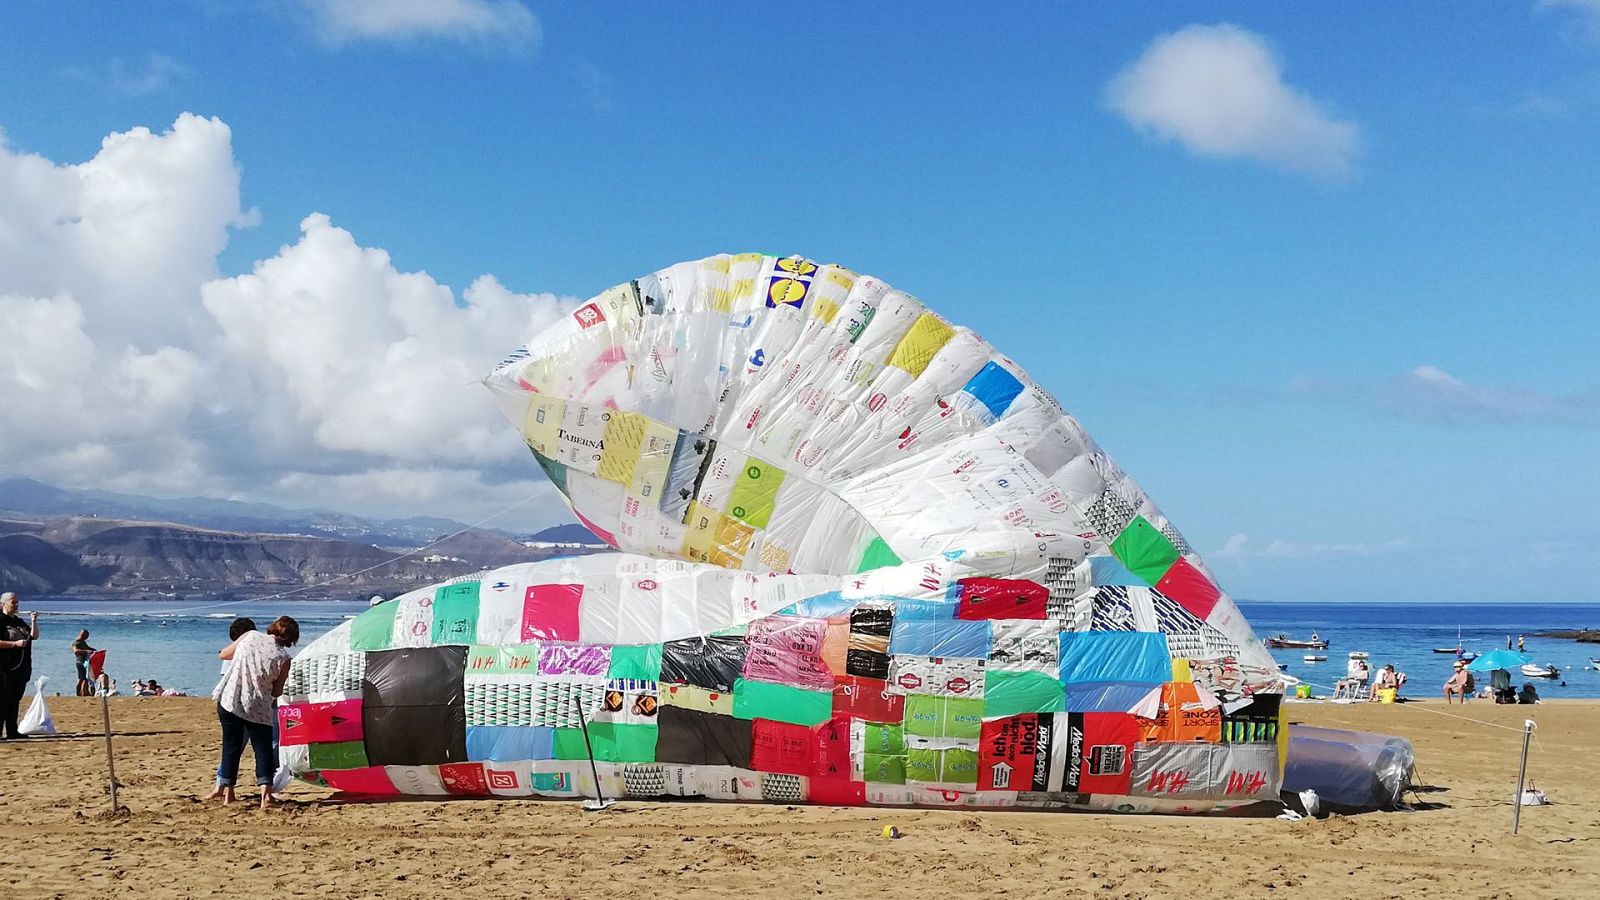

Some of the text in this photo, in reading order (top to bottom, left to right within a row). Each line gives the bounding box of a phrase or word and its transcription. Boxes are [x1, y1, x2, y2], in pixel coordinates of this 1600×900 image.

[557, 428, 605, 450] TABERNA
[1183, 718, 1219, 727] SPORT
[992, 737, 1006, 757] Ich
